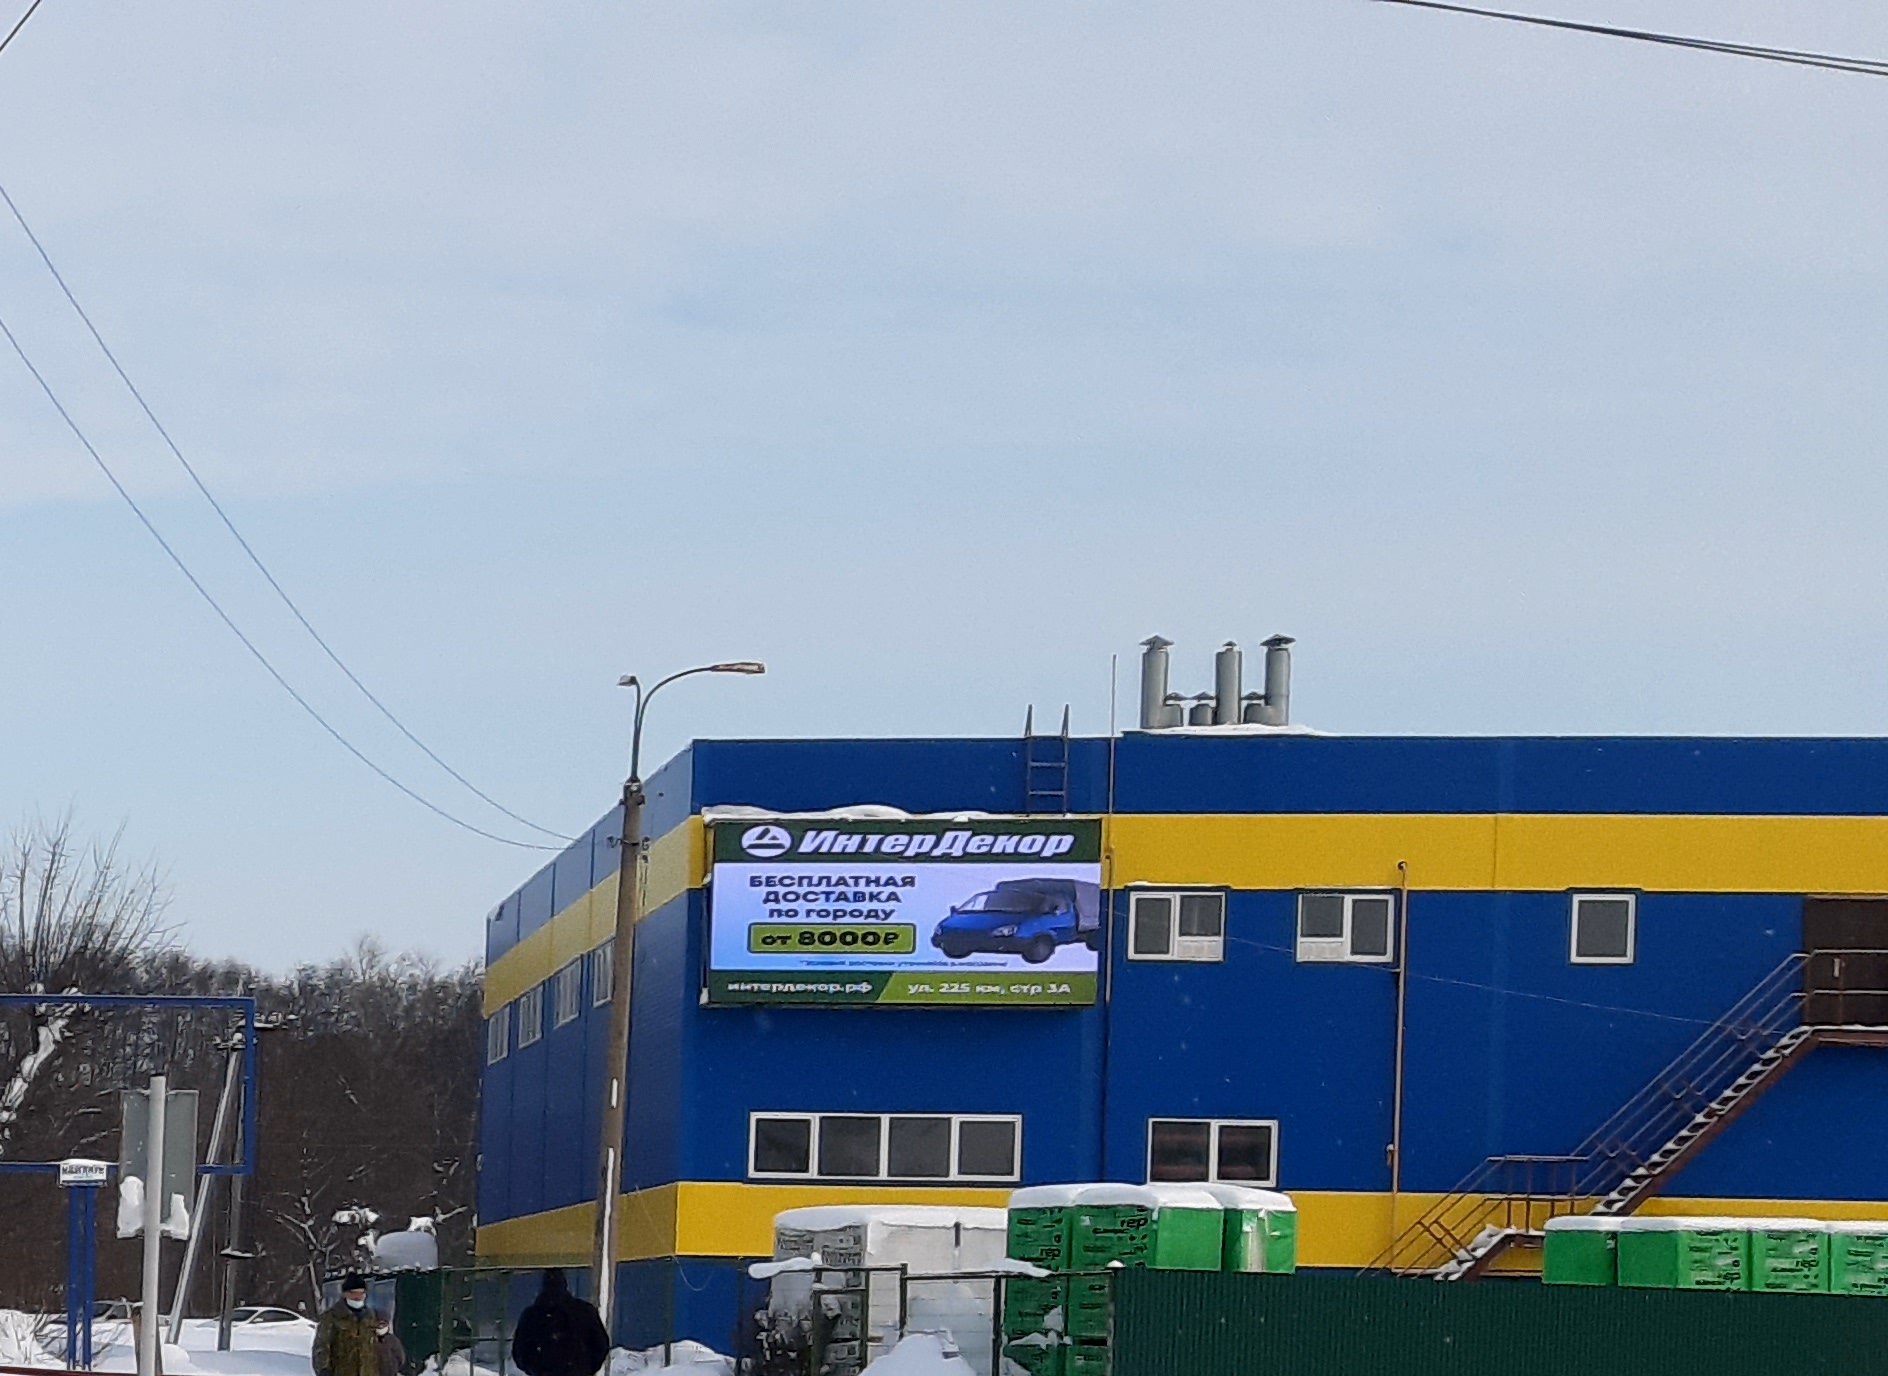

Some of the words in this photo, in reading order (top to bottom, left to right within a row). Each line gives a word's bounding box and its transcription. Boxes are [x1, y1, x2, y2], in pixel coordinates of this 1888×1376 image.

[797, 830, 1075, 858] ИнтерДекор
[749, 875, 916, 888] БЕСПЛАТНАЯ
[762, 890, 902, 905] ДОСТАВКА
[768, 908, 799, 919] по
[805, 908, 896, 921] городу
[761, 933, 792, 946] от
[727, 981, 873, 994] интердекор.рф
[907, 983, 935, 995] ул.
[938, 983, 971, 994] 225
[1009, 984, 1043, 996] стр
